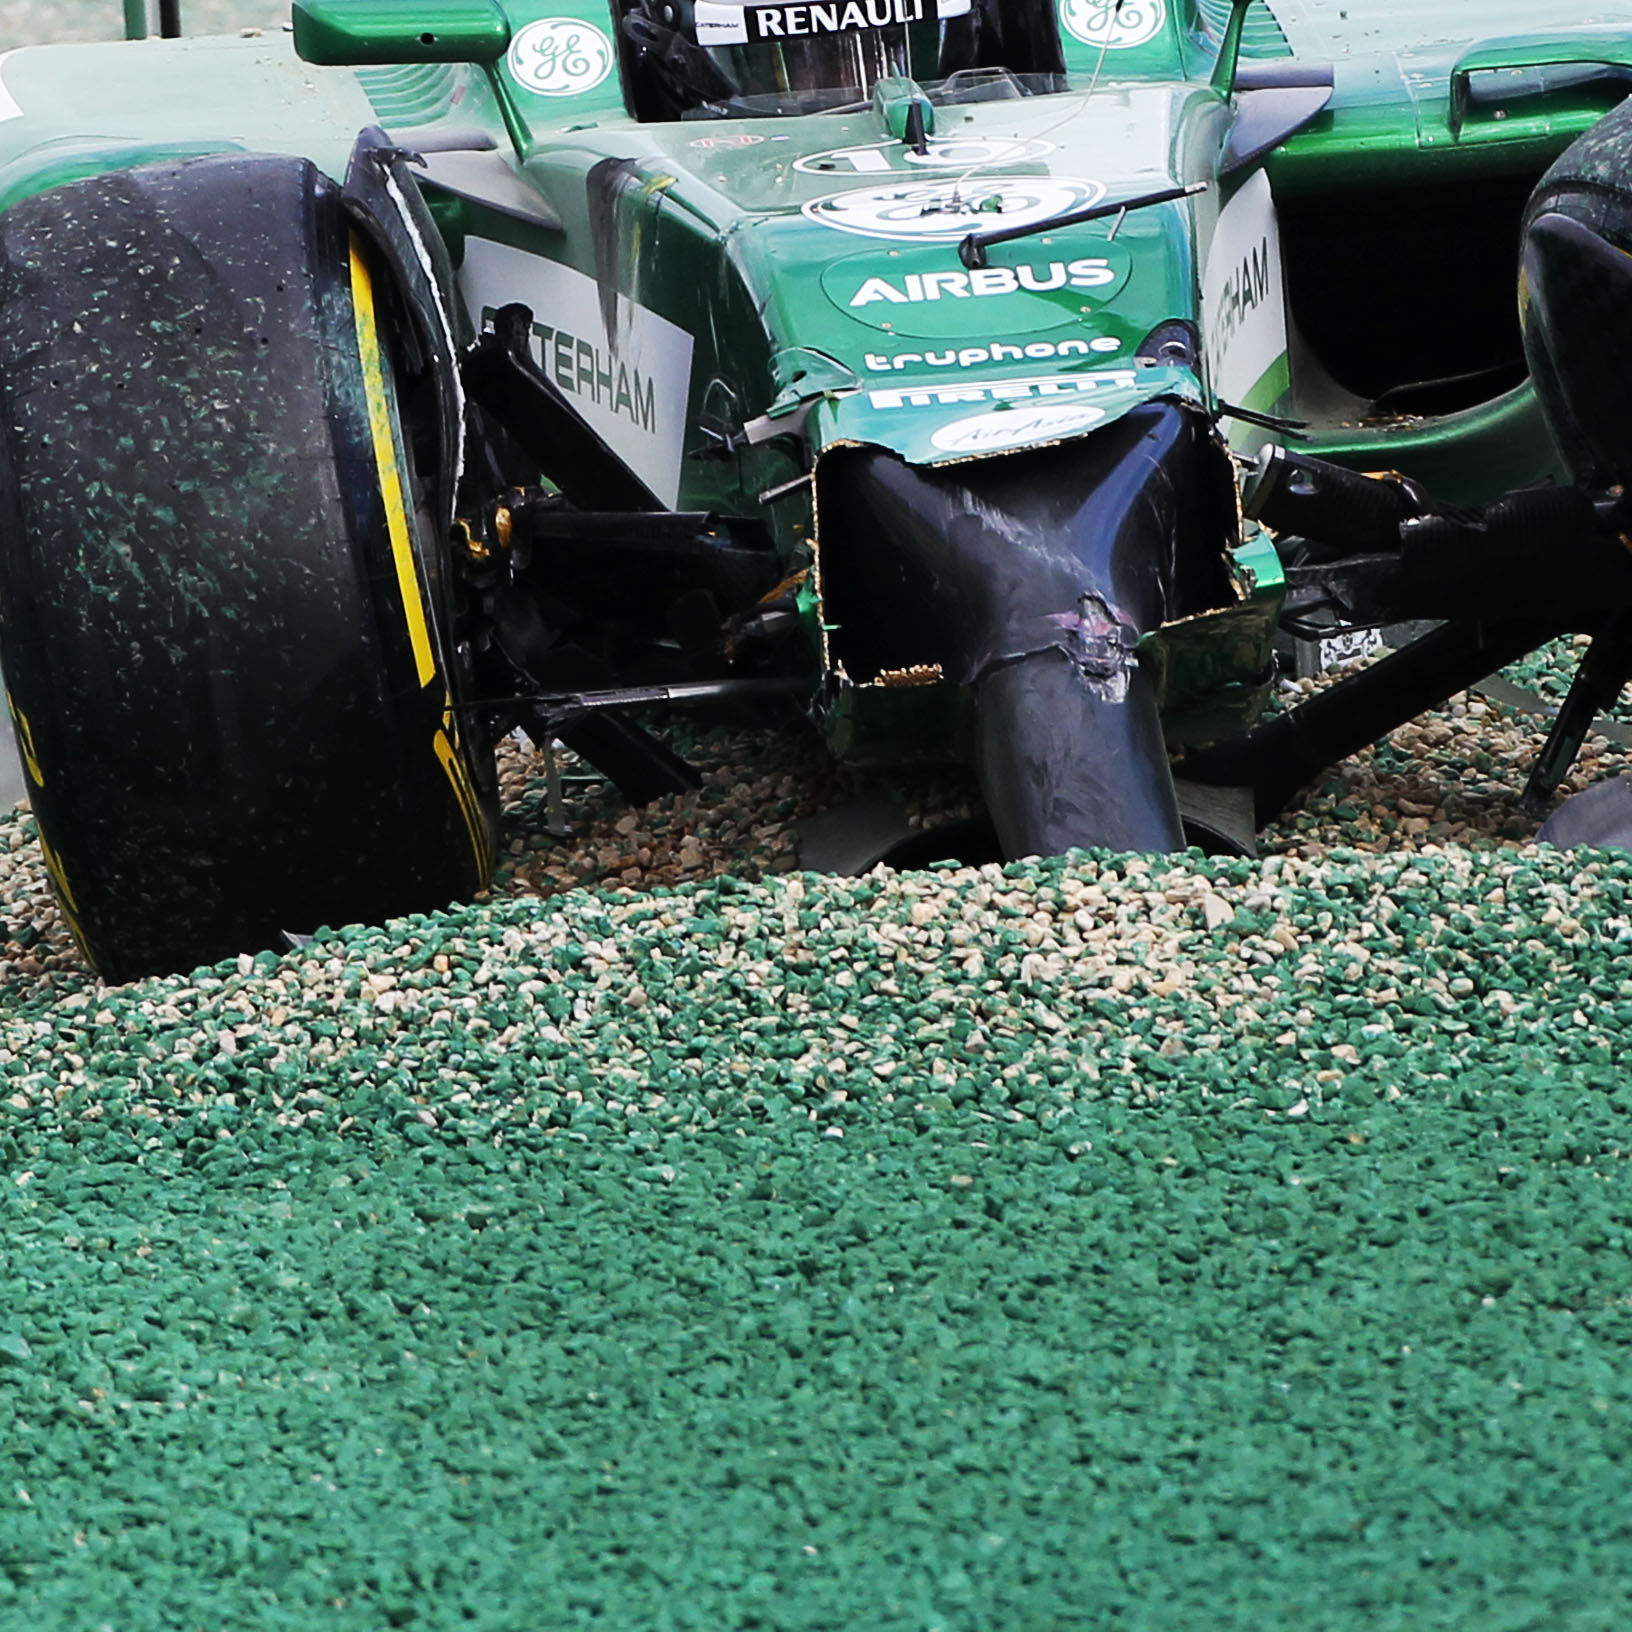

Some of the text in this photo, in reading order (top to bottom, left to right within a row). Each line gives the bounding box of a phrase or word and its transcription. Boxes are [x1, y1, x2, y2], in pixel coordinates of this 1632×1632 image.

[848, 257, 1116, 308] AIRBUS
[480, 305, 656, 435] TERHAM
[863, 336, 1122, 371] truphone
